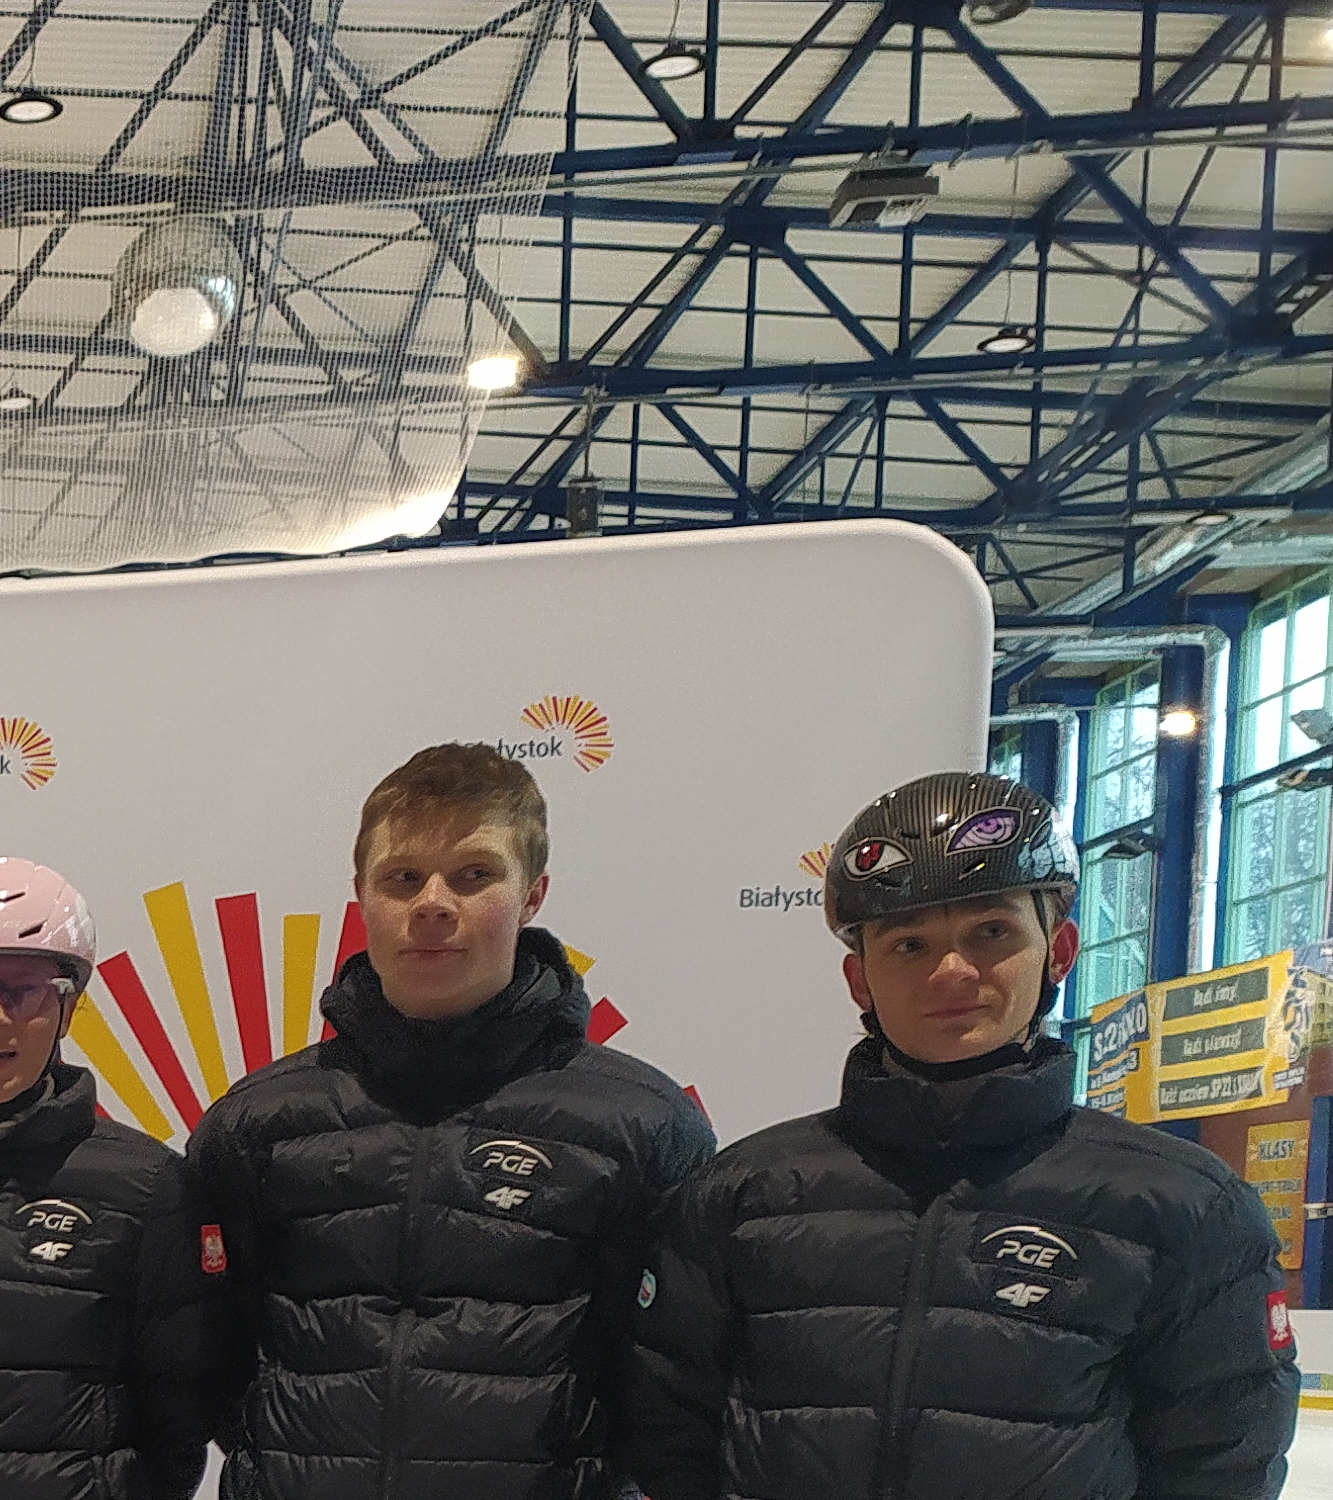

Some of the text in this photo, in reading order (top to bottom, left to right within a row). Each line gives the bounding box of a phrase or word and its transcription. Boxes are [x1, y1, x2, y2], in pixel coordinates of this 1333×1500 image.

[492, 736, 563, 761] łystok
[739, 884, 824, 913] Białysto
[482, 1151, 538, 1176] PGE
[484, 1185, 531, 1210] 4F
[27, 1210, 79, 1233] PGE
[29, 1240, 75, 1262] 4F
[995, 1239, 1059, 1270] PGE
[994, 1282, 1051, 1309] 4F
